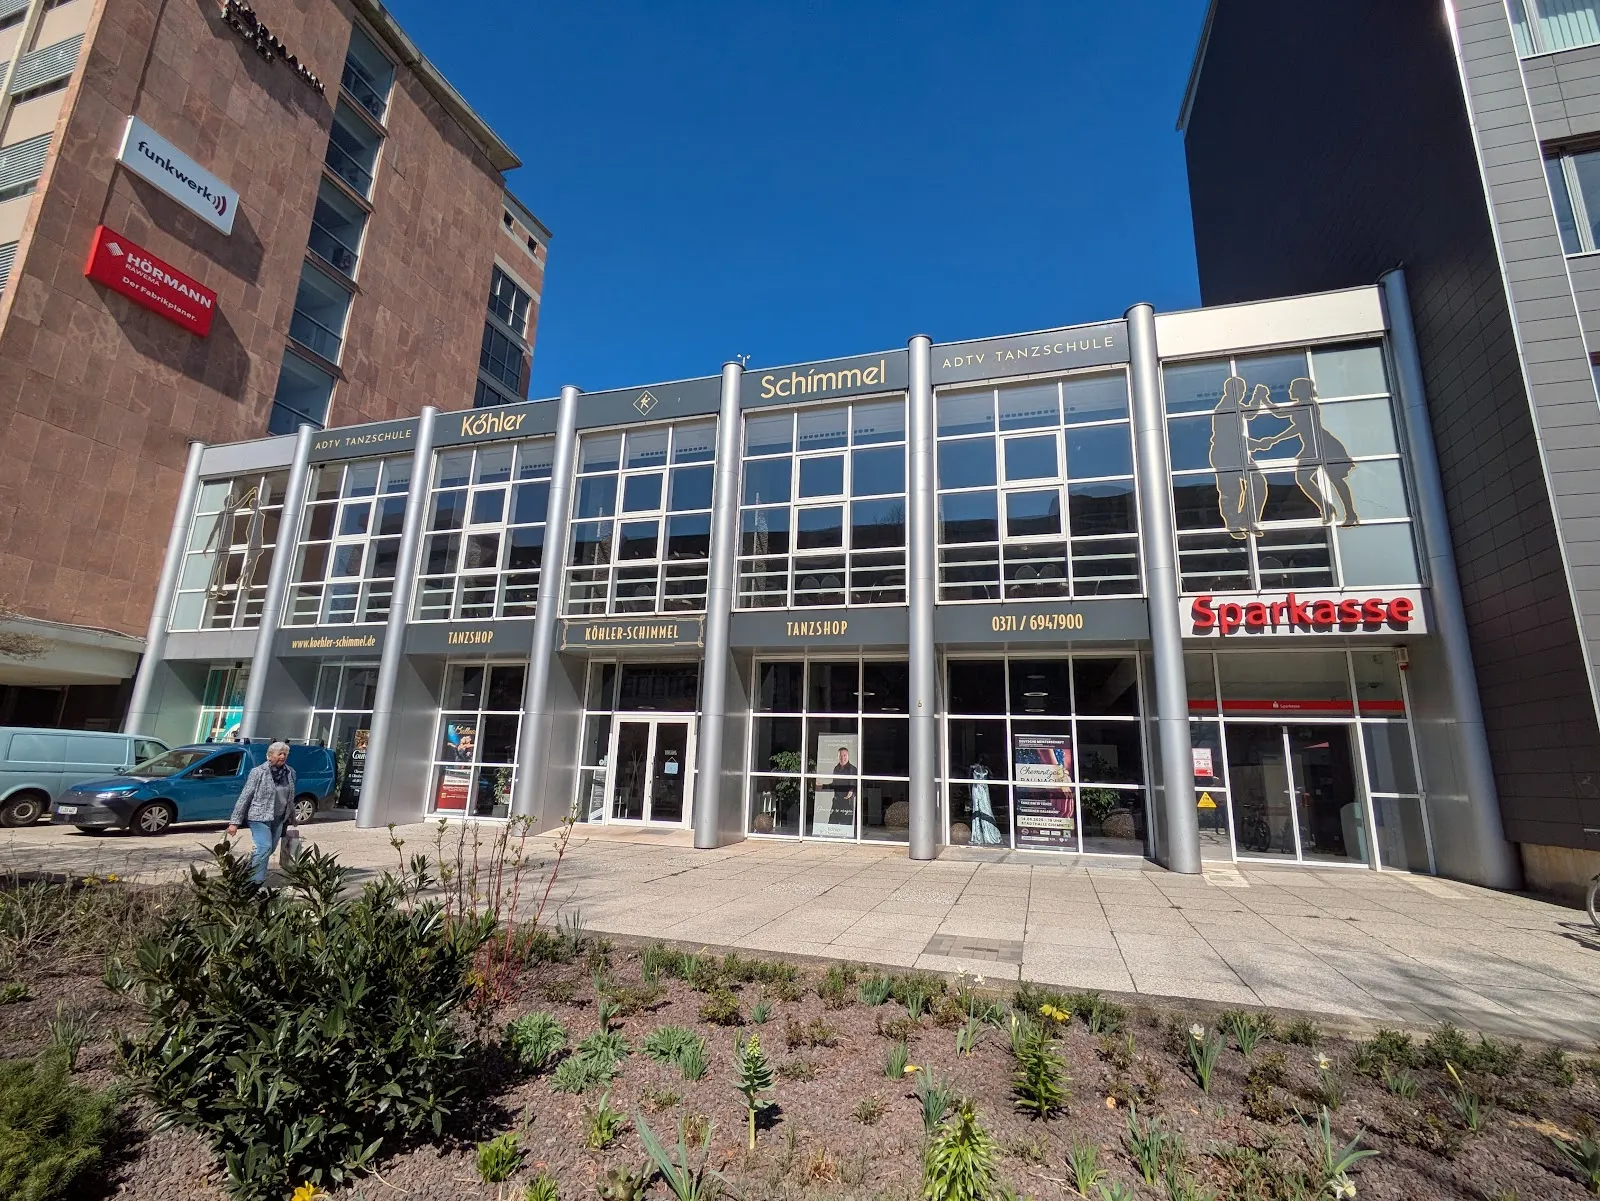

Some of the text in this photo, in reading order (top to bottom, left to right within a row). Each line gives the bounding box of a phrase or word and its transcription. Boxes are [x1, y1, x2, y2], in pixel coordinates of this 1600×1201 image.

[138, 141, 212, 202] funkwerk
[125, 263, 160, 287] RAWEMA
[127, 253, 212, 309] HÖRMANN
[122, 276, 198, 322] Der Fabrikplaner.
[940, 336, 1113, 369] ADTV TANZSCHULE
[760, 360, 886, 399] Schimmel
[314, 429, 412, 450] ADTV TANZSCHULE
[991, 615, 1017, 631] 0371
[1029, 613, 1084, 630] 6947900
[1191, 592, 1414, 634] Sparkasse
[448, 631, 494, 645] TANZSHOP
[584, 624, 679, 641] KÖHLER-SCHIMMEL
[787, 620, 848, 636] TANZSHOP
[291, 635, 376, 649] www.koehler-schimmel.de
